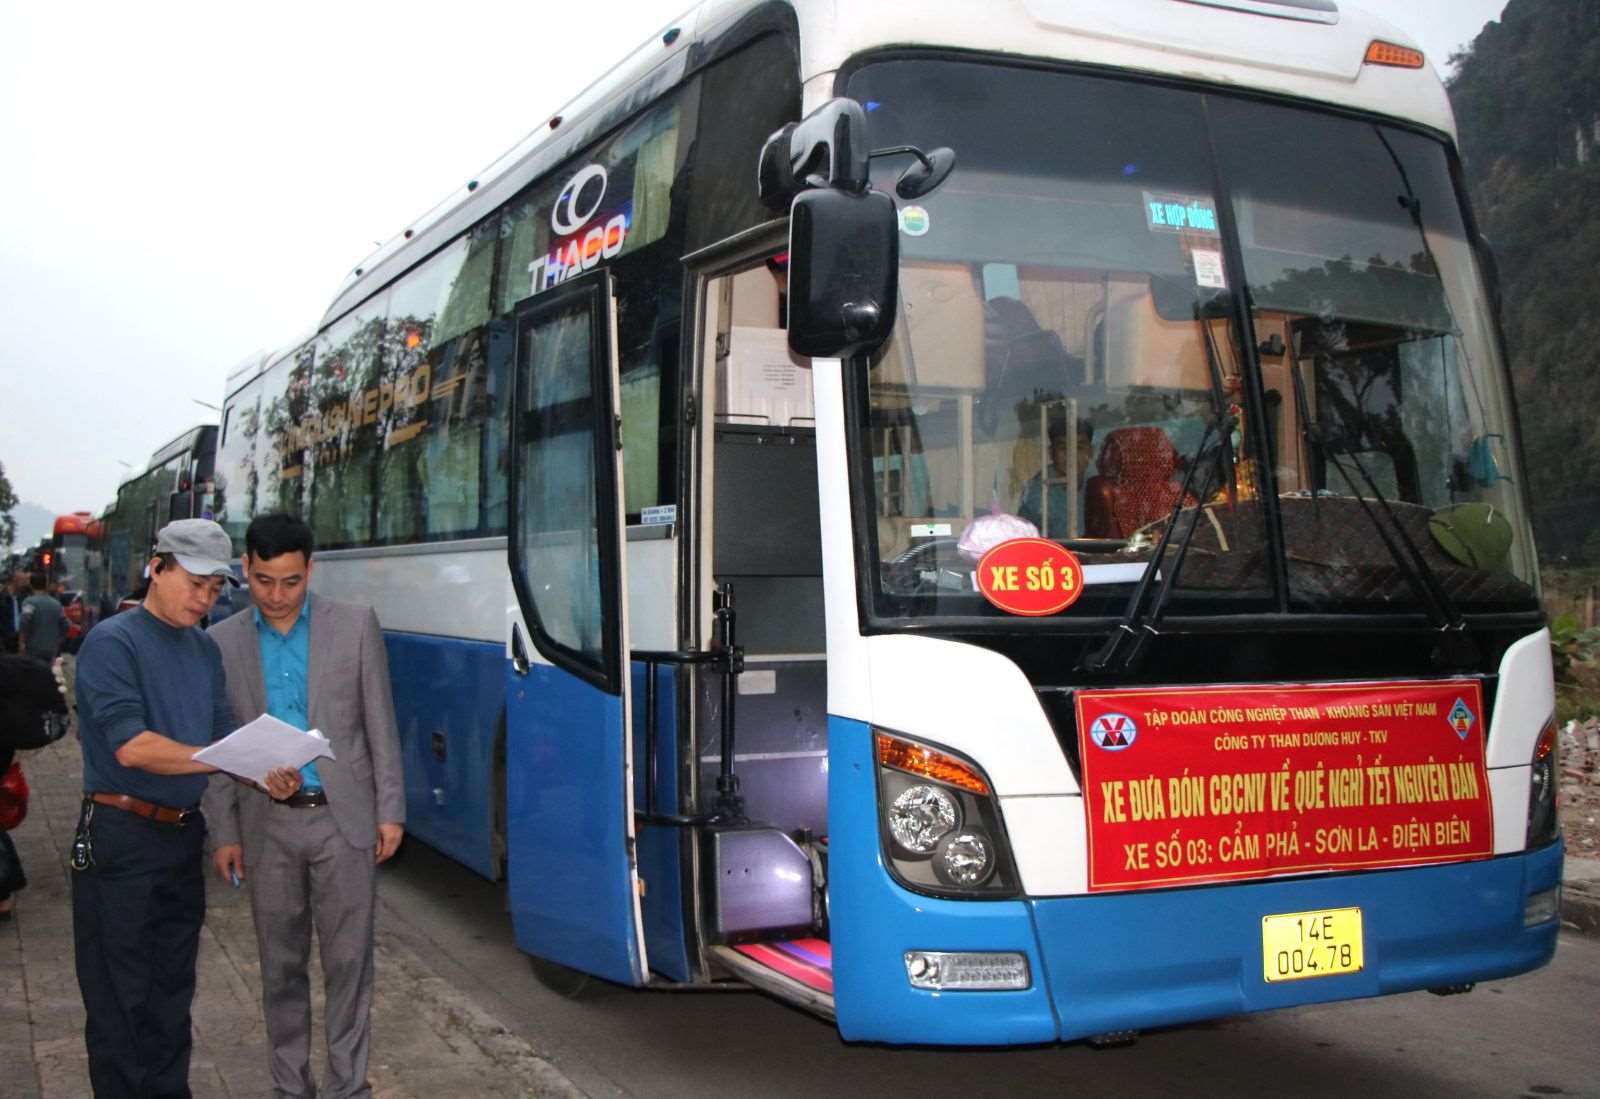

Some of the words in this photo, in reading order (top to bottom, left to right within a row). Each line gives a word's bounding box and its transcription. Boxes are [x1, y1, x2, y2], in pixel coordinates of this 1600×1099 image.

[1149, 202, 1166, 224] XE
[527, 213, 626, 297] THACO
[990, 566, 1020, 591] XE
[1026, 558, 1055, 591] SỐ
[1060, 566, 1074, 591] 3
[1144, 708, 1168, 730] TẬP
[1171, 706, 1206, 725] ĐOÀN
[1210, 705, 1244, 723] CÔNG
[1246, 704, 1287, 725] NGHIỆP
[1288, 706, 1320, 720] THAN
[1393, 700, 1414, 720] VIỆT
[1415, 703, 1437, 716] NAM
[1214, 732, 1248, 750] CÔNG
[1251, 735, 1266, 749] TY
[1269, 733, 1300, 748] THAN
[1341, 731, 1361, 745] HUY
[1368, 730, 1388, 744] TKV
[1101, 781, 1127, 823] XE
[1129, 774, 1166, 821] ĐƯA
[1168, 768, 1205, 818] ĐÓN
[1209, 772, 1266, 816] CBCNV
[1270, 757, 1290, 811] VỀ
[1294, 760, 1325, 814] QUÊ
[1328, 754, 1364, 808] NGHỈ
[1366, 754, 1391, 805] TẾT
[1393, 755, 1449, 804] NGUYÊN
[1449, 754, 1479, 800] ĐÁN
[1124, 843, 1150, 871] XE
[1155, 829, 1182, 868] SỐ
[1187, 839, 1213, 865] 03:
[1219, 820, 1260, 863] CẨM
[1265, 821, 1300, 859] PHẢ
[1315, 825, 1352, 854] SƠN
[1358, 826, 1379, 851] LA
[1392, 817, 1430, 853] ĐIỆN
[1435, 814, 1471, 846] BIÊN
[1297, 916, 1334, 942] 14E
[1278, 944, 1352, 975] 004.78
